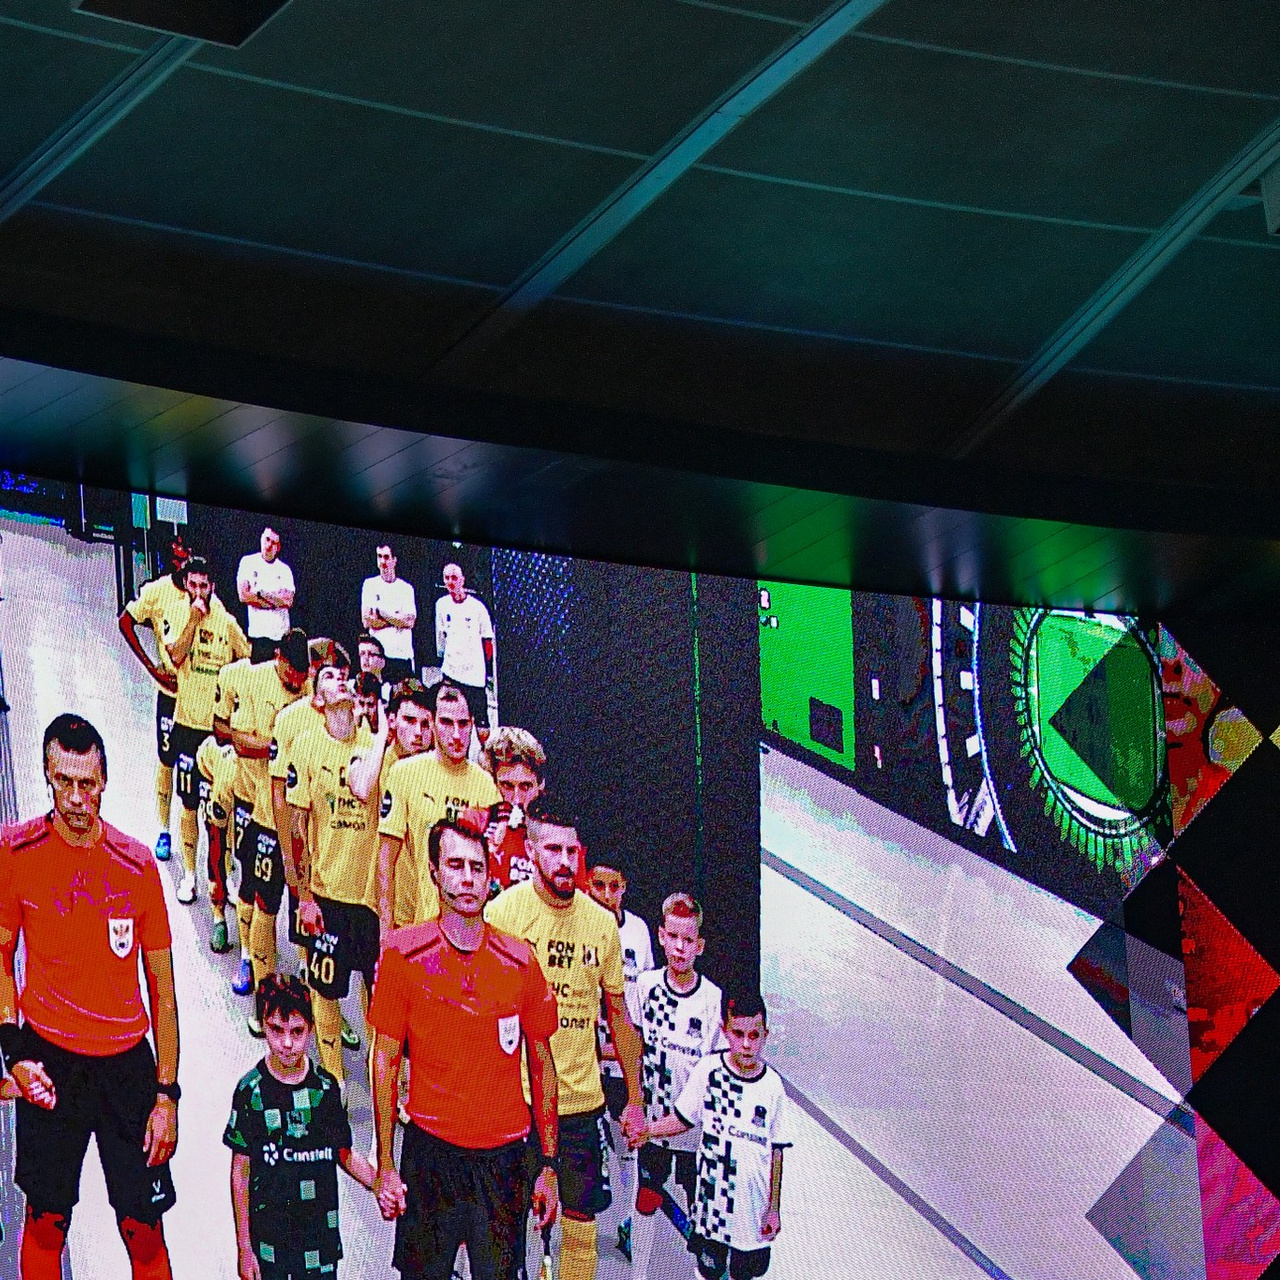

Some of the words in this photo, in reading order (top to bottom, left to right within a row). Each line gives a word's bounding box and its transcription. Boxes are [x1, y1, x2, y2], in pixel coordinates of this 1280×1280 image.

[547, 938, 575, 954] FON
[310, 952, 335, 985] 40
[548, 954, 573, 969] BET
